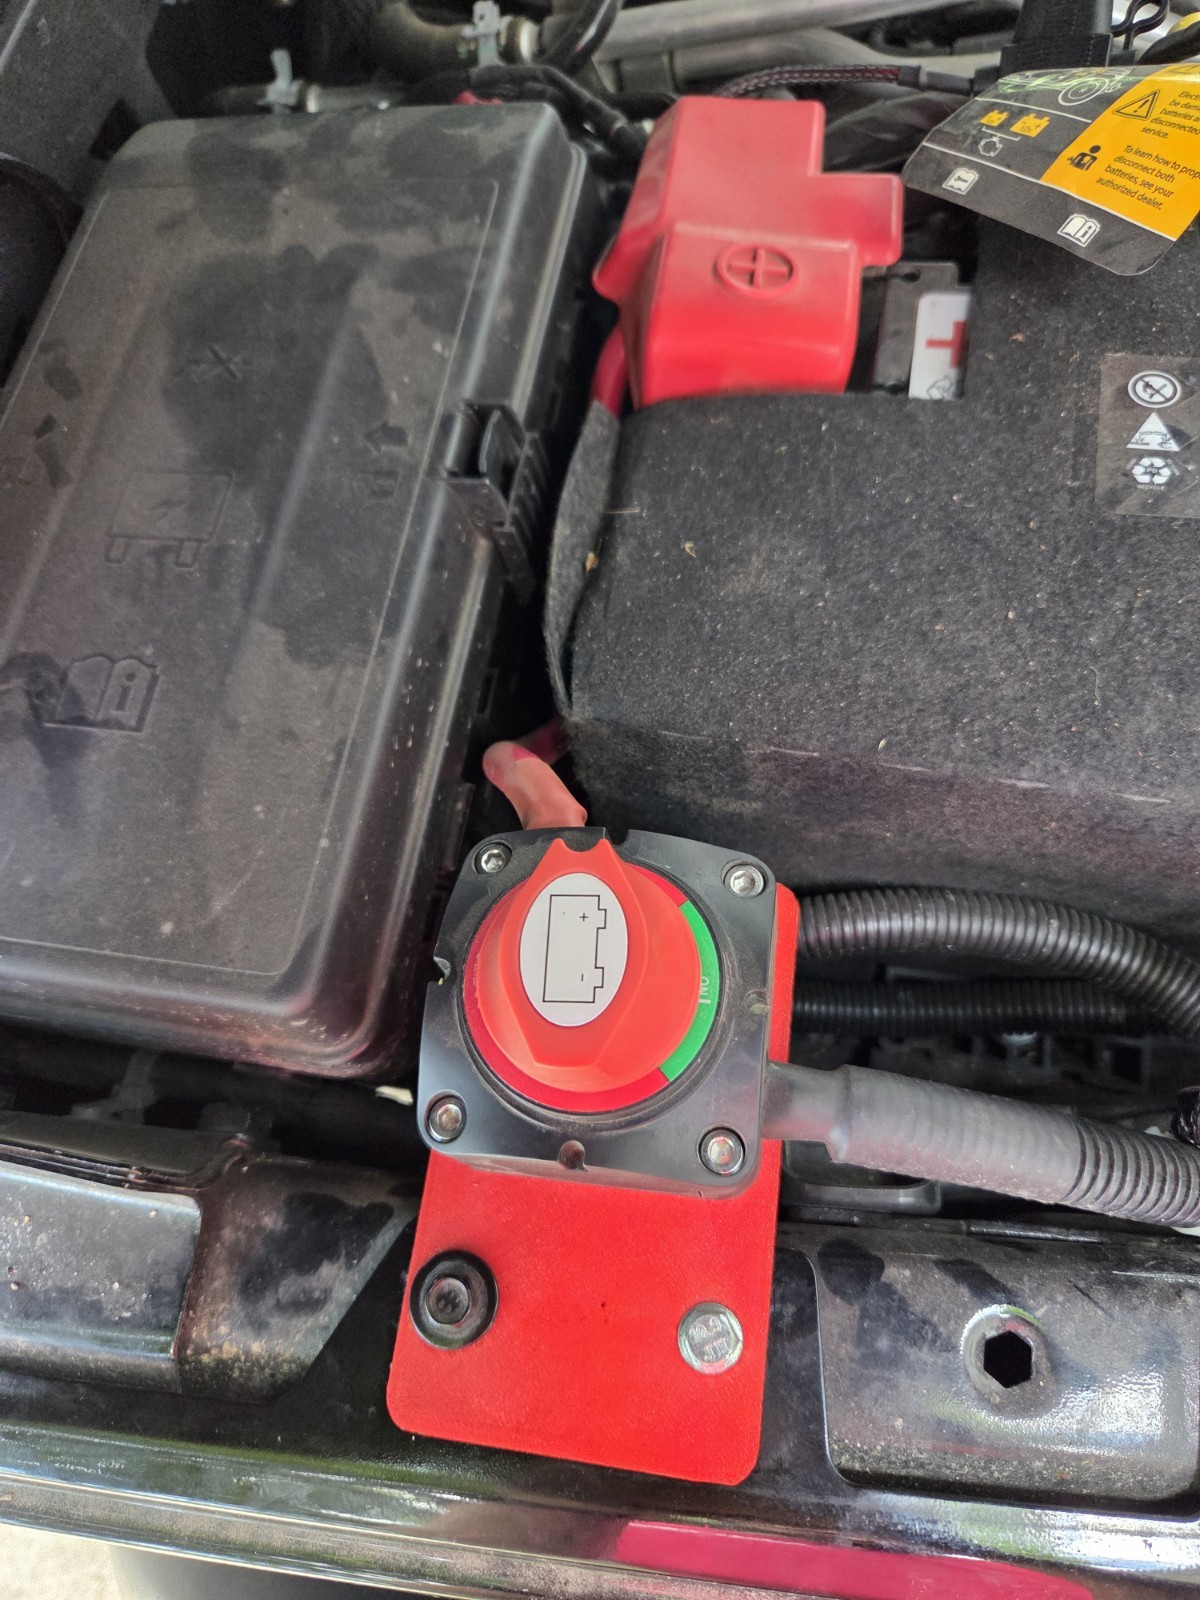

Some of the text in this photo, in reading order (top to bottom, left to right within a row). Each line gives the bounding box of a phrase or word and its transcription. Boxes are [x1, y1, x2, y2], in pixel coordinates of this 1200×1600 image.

[1160, 108, 1194, 121] batteries
[1169, 99, 1180, 107] be
[1113, 154, 1175, 183] disconnect both
[1123, 144, 1200, 180] To learn how to prop
[1096, 176, 1164, 210] authorized dealer.
[1104, 164, 1174, 199] batteries, see your
